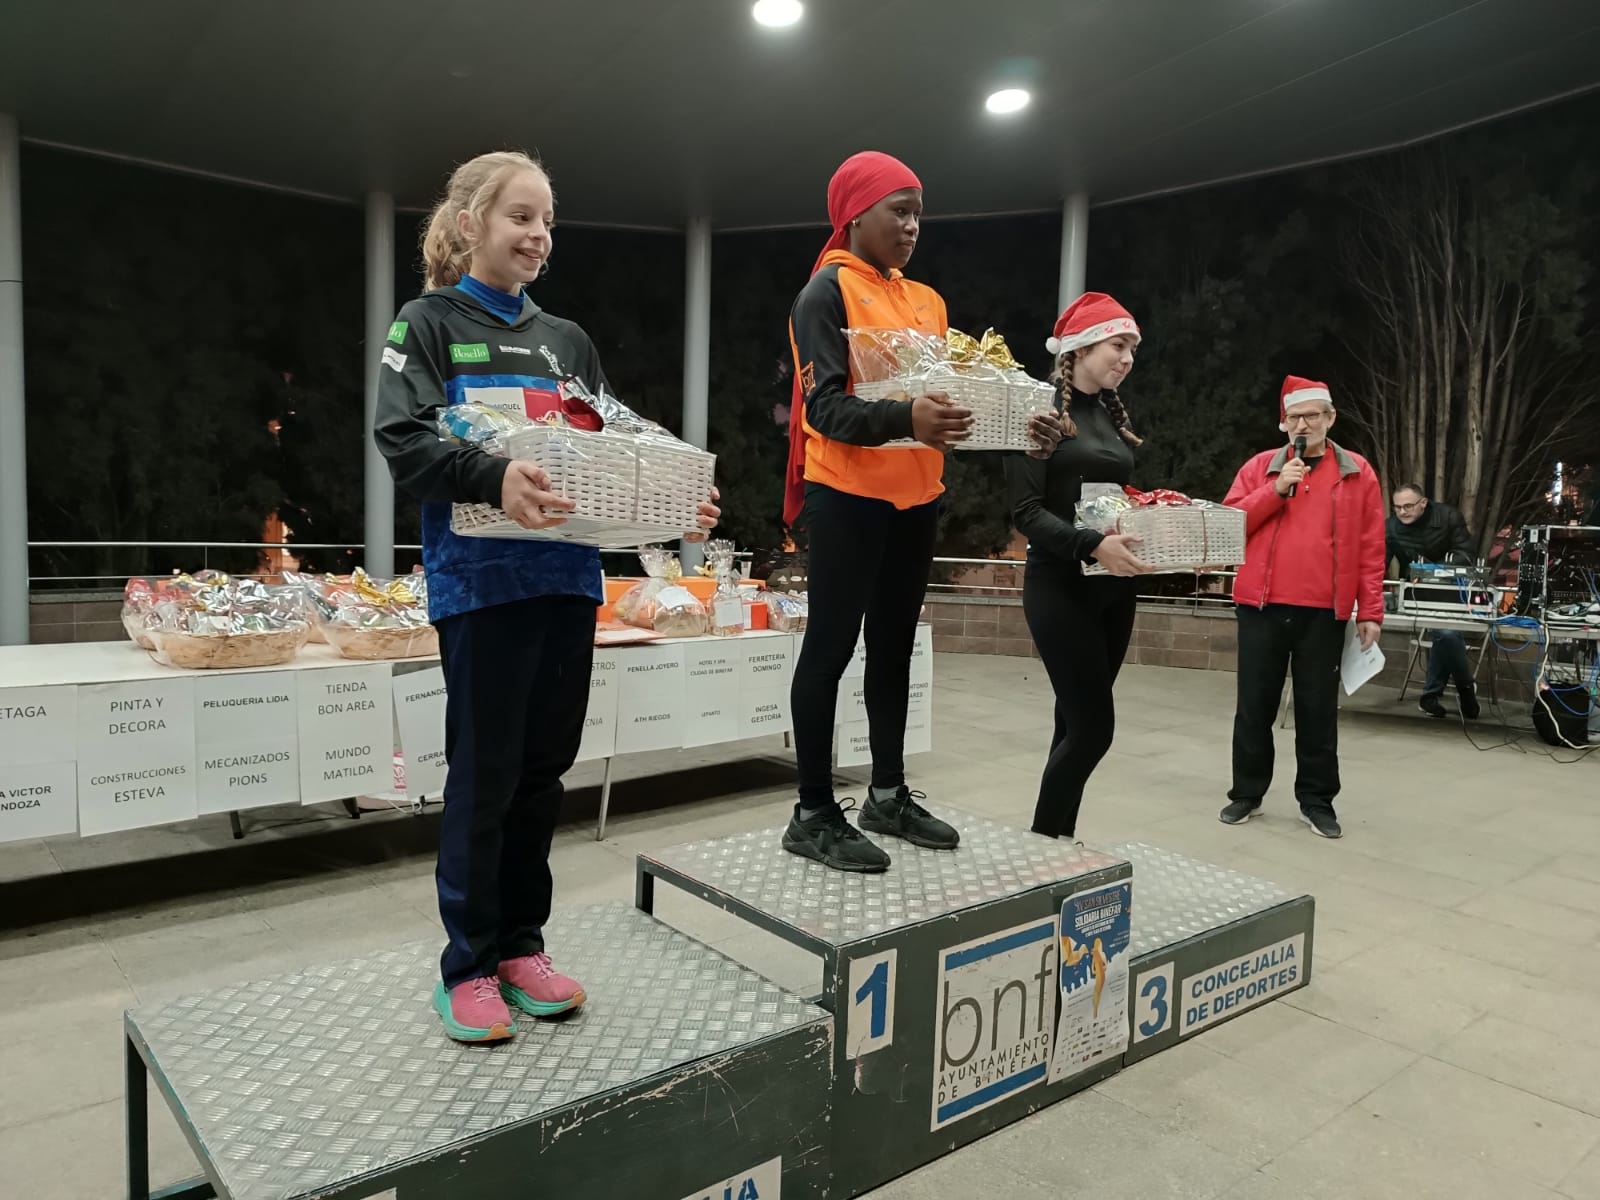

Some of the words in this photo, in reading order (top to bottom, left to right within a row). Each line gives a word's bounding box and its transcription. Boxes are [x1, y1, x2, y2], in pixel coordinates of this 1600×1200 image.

[748, 653, 786, 664] FERRETERIA
[627, 664, 654, 673] PENELLA
[655, 662, 679, 671] JOYERO
[753, 663, 782, 673] DOMINGO
[325, 681, 367, 695] TIENDA
[405, 688, 447, 702] FERNANDO
[110, 699, 152, 713] PINTA
[155, 697, 164, 708] Y
[203, 696, 264, 709] PELUQUERIA
[266, 695, 289, 705] LIDIA
[318, 702, 343, 715] BON
[346, 700, 375, 713] AREA
[755, 703, 778, 713] INGESA
[751, 713, 782, 724] GESTORIA
[109, 719, 166, 735] DECORA
[204, 751, 290, 770] MECANIZADOS
[325, 745, 371, 761] MUNDO
[417, 751, 445, 763] CERRA
[435, 759, 447, 768] GA
[90, 765, 186, 786] CONSTRUCCIONES
[229, 773, 268, 787] PIONS
[323, 765, 374, 781] MATILDA
[9, 786, 52, 798] VICTOR
[114, 786, 166, 803] ESTEVA
[0, 799, 41, 811] NDOZA
[855, 960, 889, 1039] 1
[1186, 1001, 1208, 1027] DE
[1213, 965, 1297, 1014] DEPORTES
[939, 943, 1053, 1073] bnf
[1138, 975, 1168, 1037] 3
[938, 1033, 1049, 1089] AYUNTAMIENTO
[937, 1088, 958, 1105] DE
